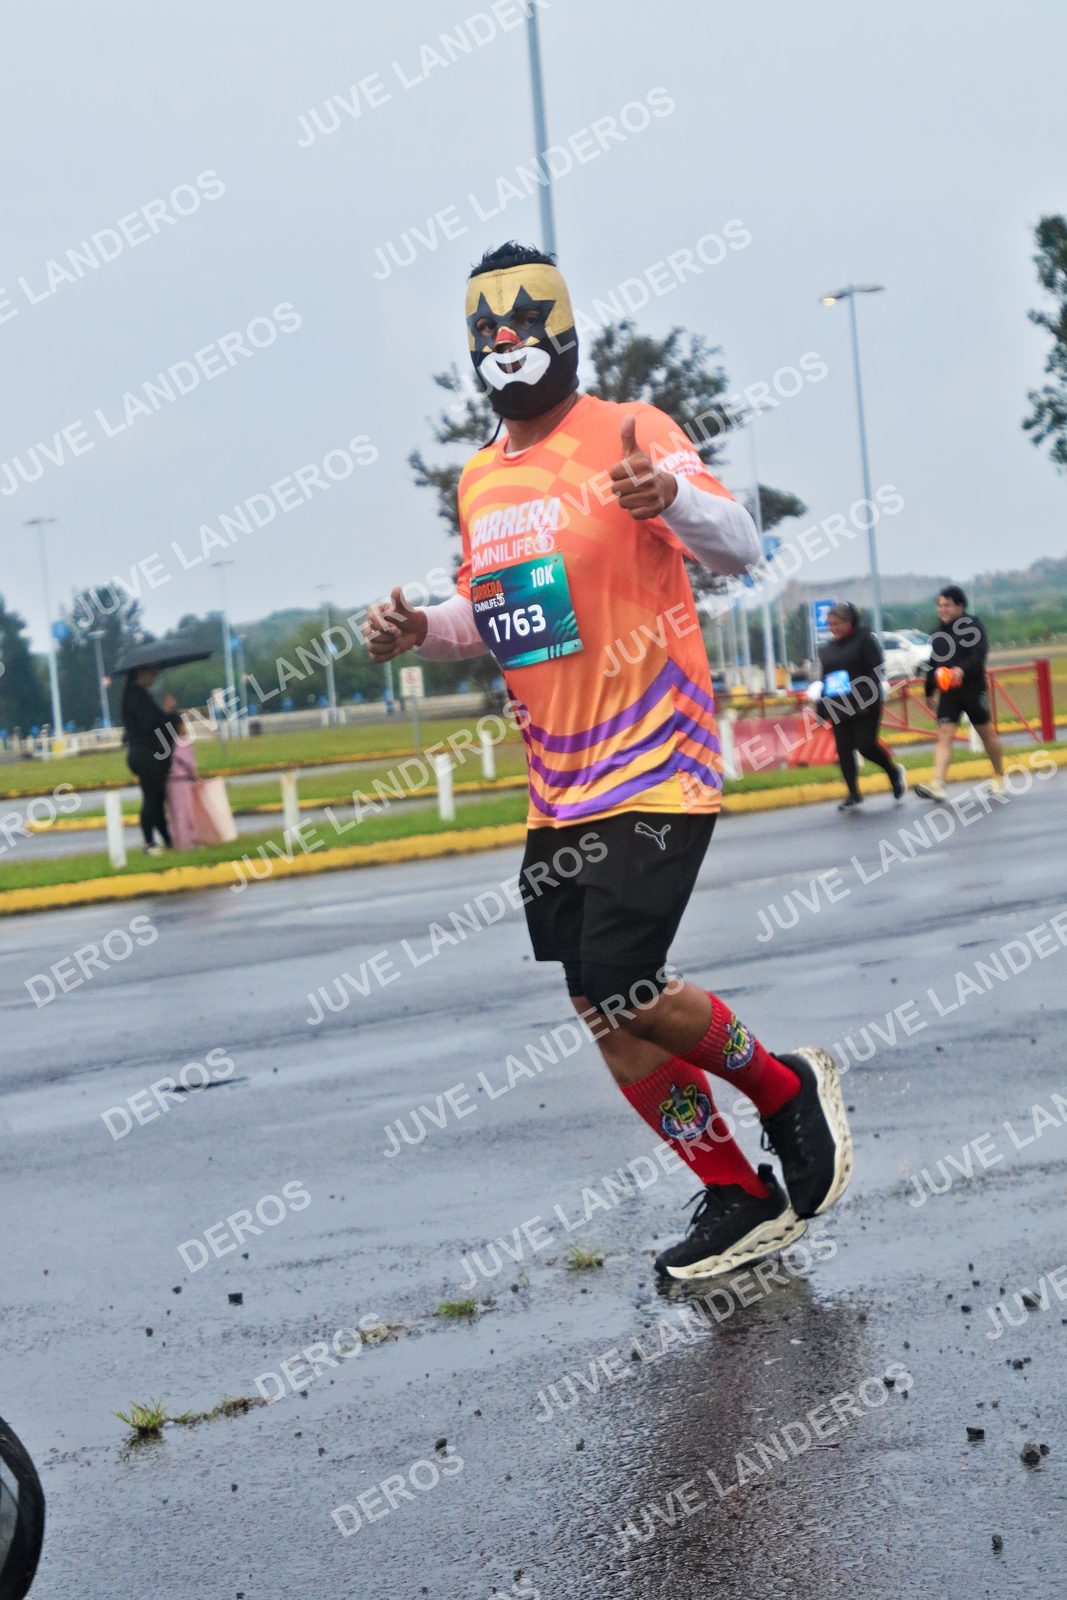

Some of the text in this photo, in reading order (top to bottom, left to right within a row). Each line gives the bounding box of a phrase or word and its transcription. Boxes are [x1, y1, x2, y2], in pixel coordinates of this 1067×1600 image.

[471, 497, 561, 549] CARRERA
[471, 536, 534, 572] OMNILIFE
[530, 564, 555, 588] 10K
[488, 604, 547, 643] 1763
